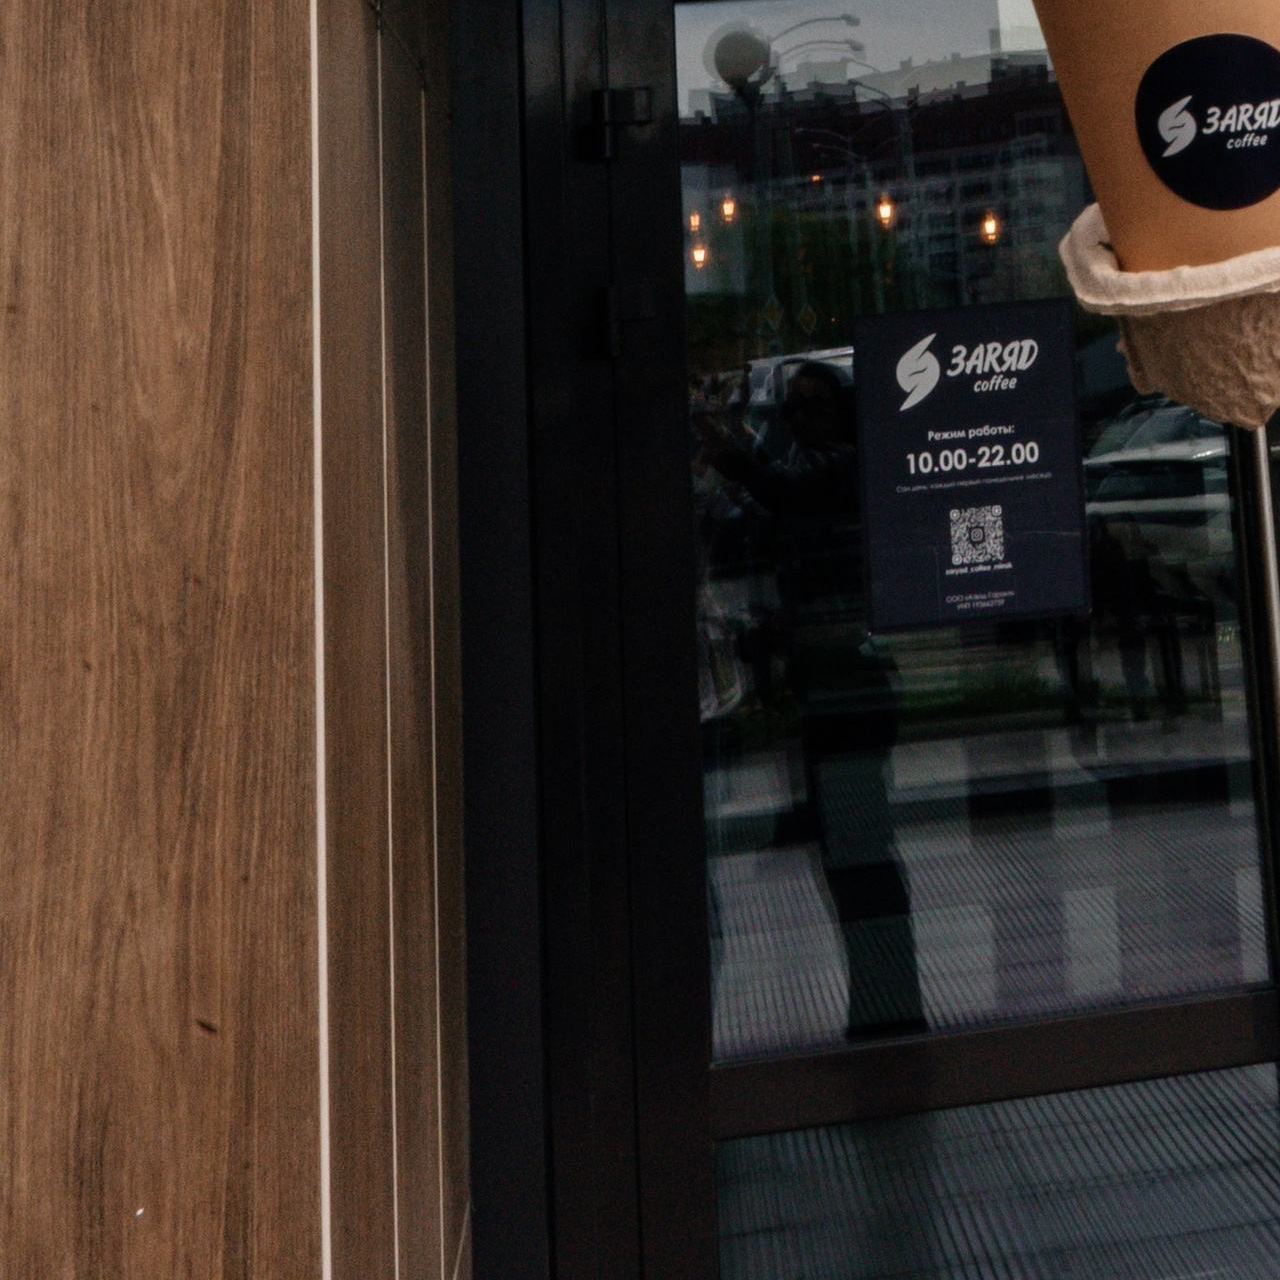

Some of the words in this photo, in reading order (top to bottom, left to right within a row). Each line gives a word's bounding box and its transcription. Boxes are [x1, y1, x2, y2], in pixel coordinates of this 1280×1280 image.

[1226, 132, 1269, 150] coffee
[973, 374, 1018, 393] coffee
[928, 429, 966, 442] Режим
[968, 424, 1015, 440] работы:
[906, 441, 1040, 475] 10.00-22.00
